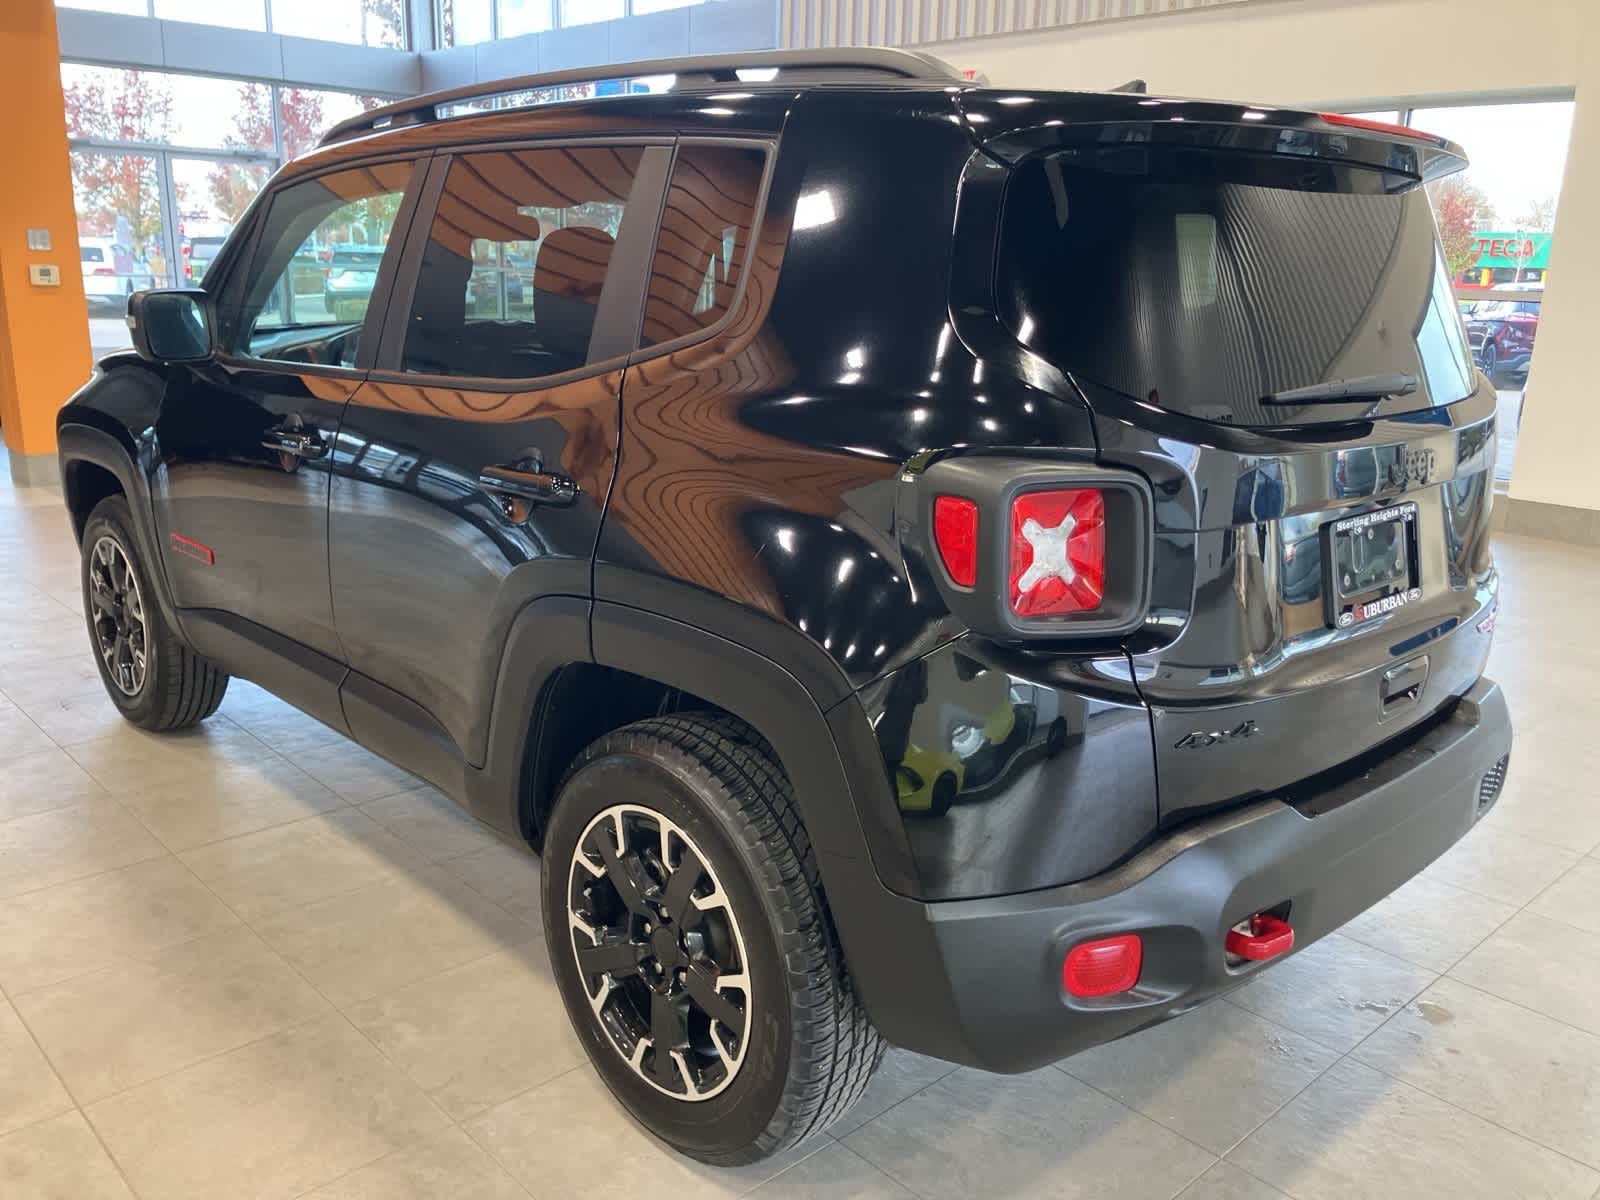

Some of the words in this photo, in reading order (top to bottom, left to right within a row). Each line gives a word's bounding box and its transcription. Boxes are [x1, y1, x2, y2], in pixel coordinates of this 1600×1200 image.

[1388, 447, 1435, 488] Jeep
[1337, 517, 1369, 532] Sterling
[1371, 508, 1399, 522] Heights
[1400, 503, 1415, 515] Ford
